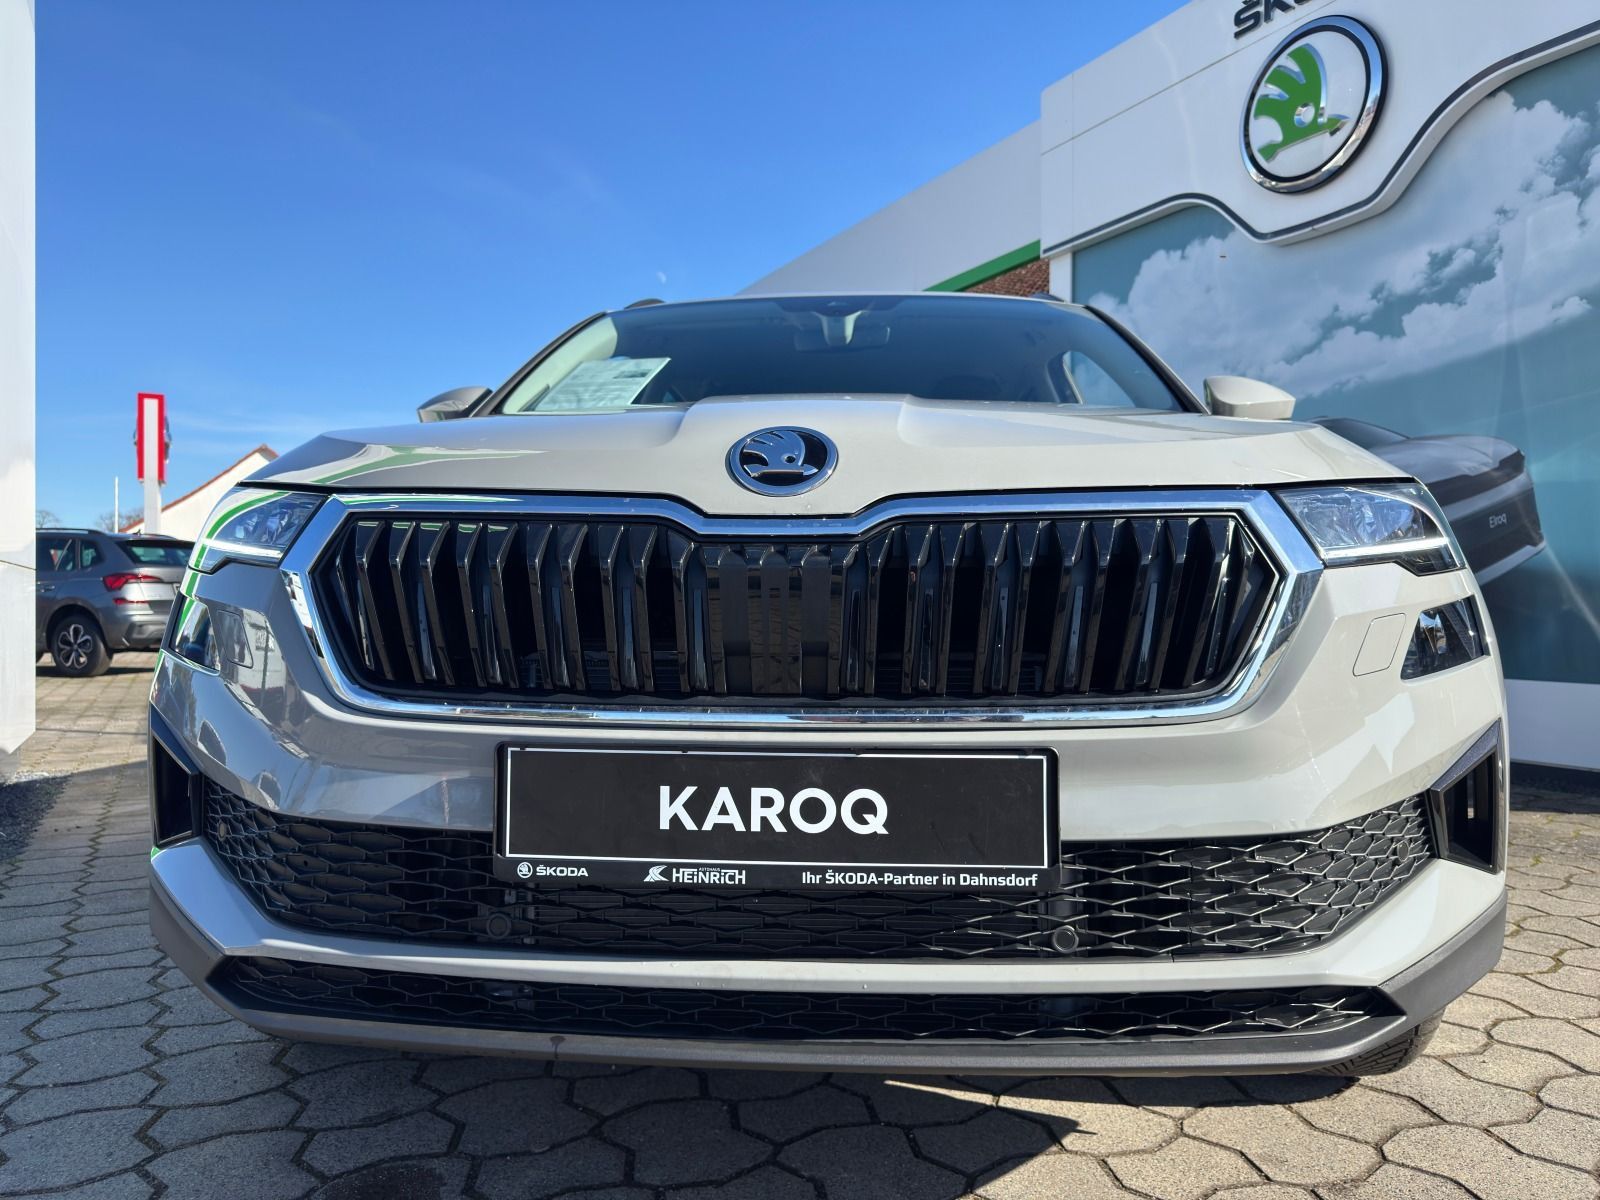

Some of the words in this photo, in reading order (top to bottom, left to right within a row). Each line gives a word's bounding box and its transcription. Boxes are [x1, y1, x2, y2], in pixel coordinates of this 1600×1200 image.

[1233, 0, 1313, 40] ŠK
[1489, 513, 1507, 528] Elroq
[659, 785, 889, 835] KAROQ
[536, 864, 589, 877] ŠKODA
[801, 871, 823, 884] Ihr
[825, 869, 940, 886] ŠKODA-Partner
[942, 872, 956, 886] in
[959, 873, 1038, 887] Dahnsdorf
